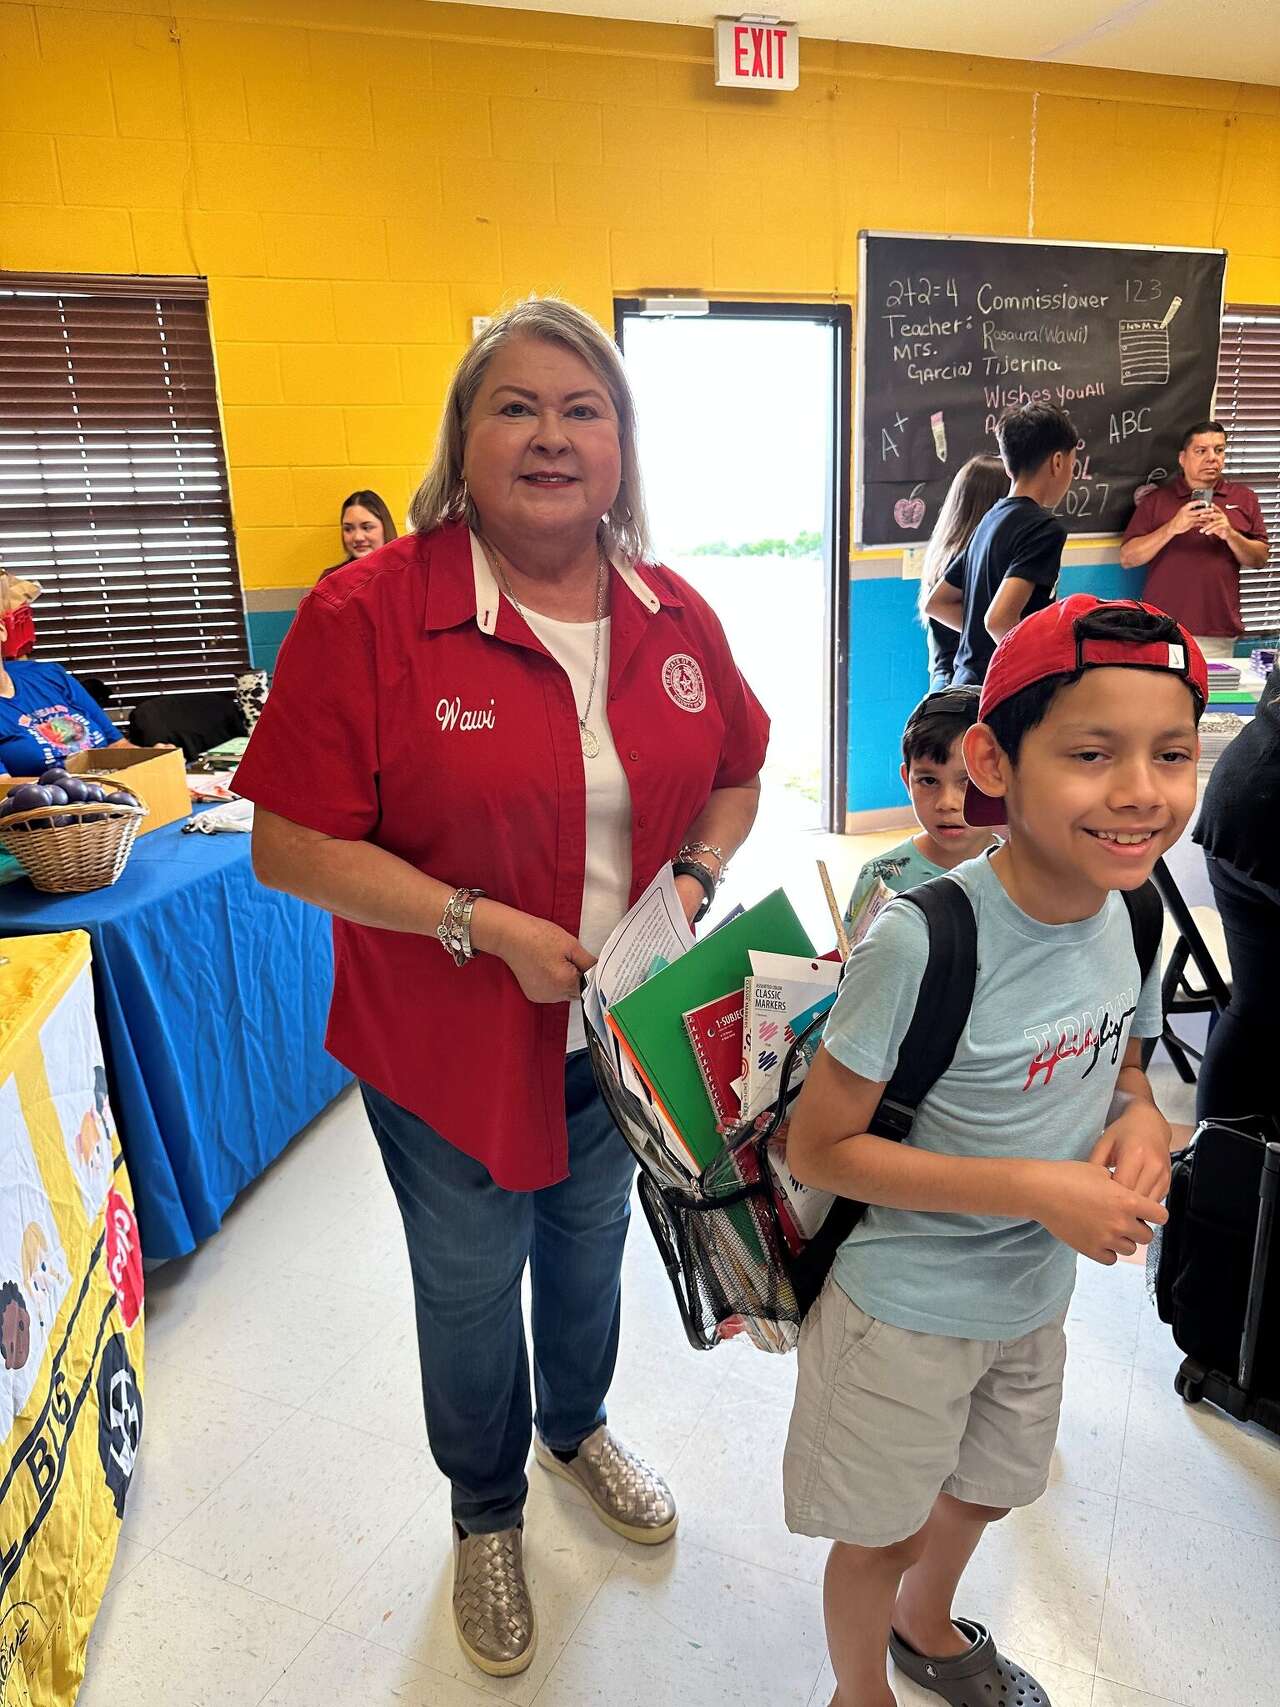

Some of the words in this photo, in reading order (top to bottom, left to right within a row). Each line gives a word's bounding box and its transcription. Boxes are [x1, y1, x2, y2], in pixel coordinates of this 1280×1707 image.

[735, 26, 787, 79] EXIT
[977, 283, 1109, 314] Commissioner
[893, 342, 938, 361] Mrs.
[982, 355, 1061, 376] Tijerina
[881, 411, 909, 461] A+
[1109, 408, 1152, 445] ABC
[436, 697, 496, 731] Wawi
[755, 988, 781, 1000] CLASSIC
[755, 998, 786, 1011] MARKERS
[715, 1008, 744, 1029] 1-SUBJEC
[26, 1371, 72, 1503] BIG
